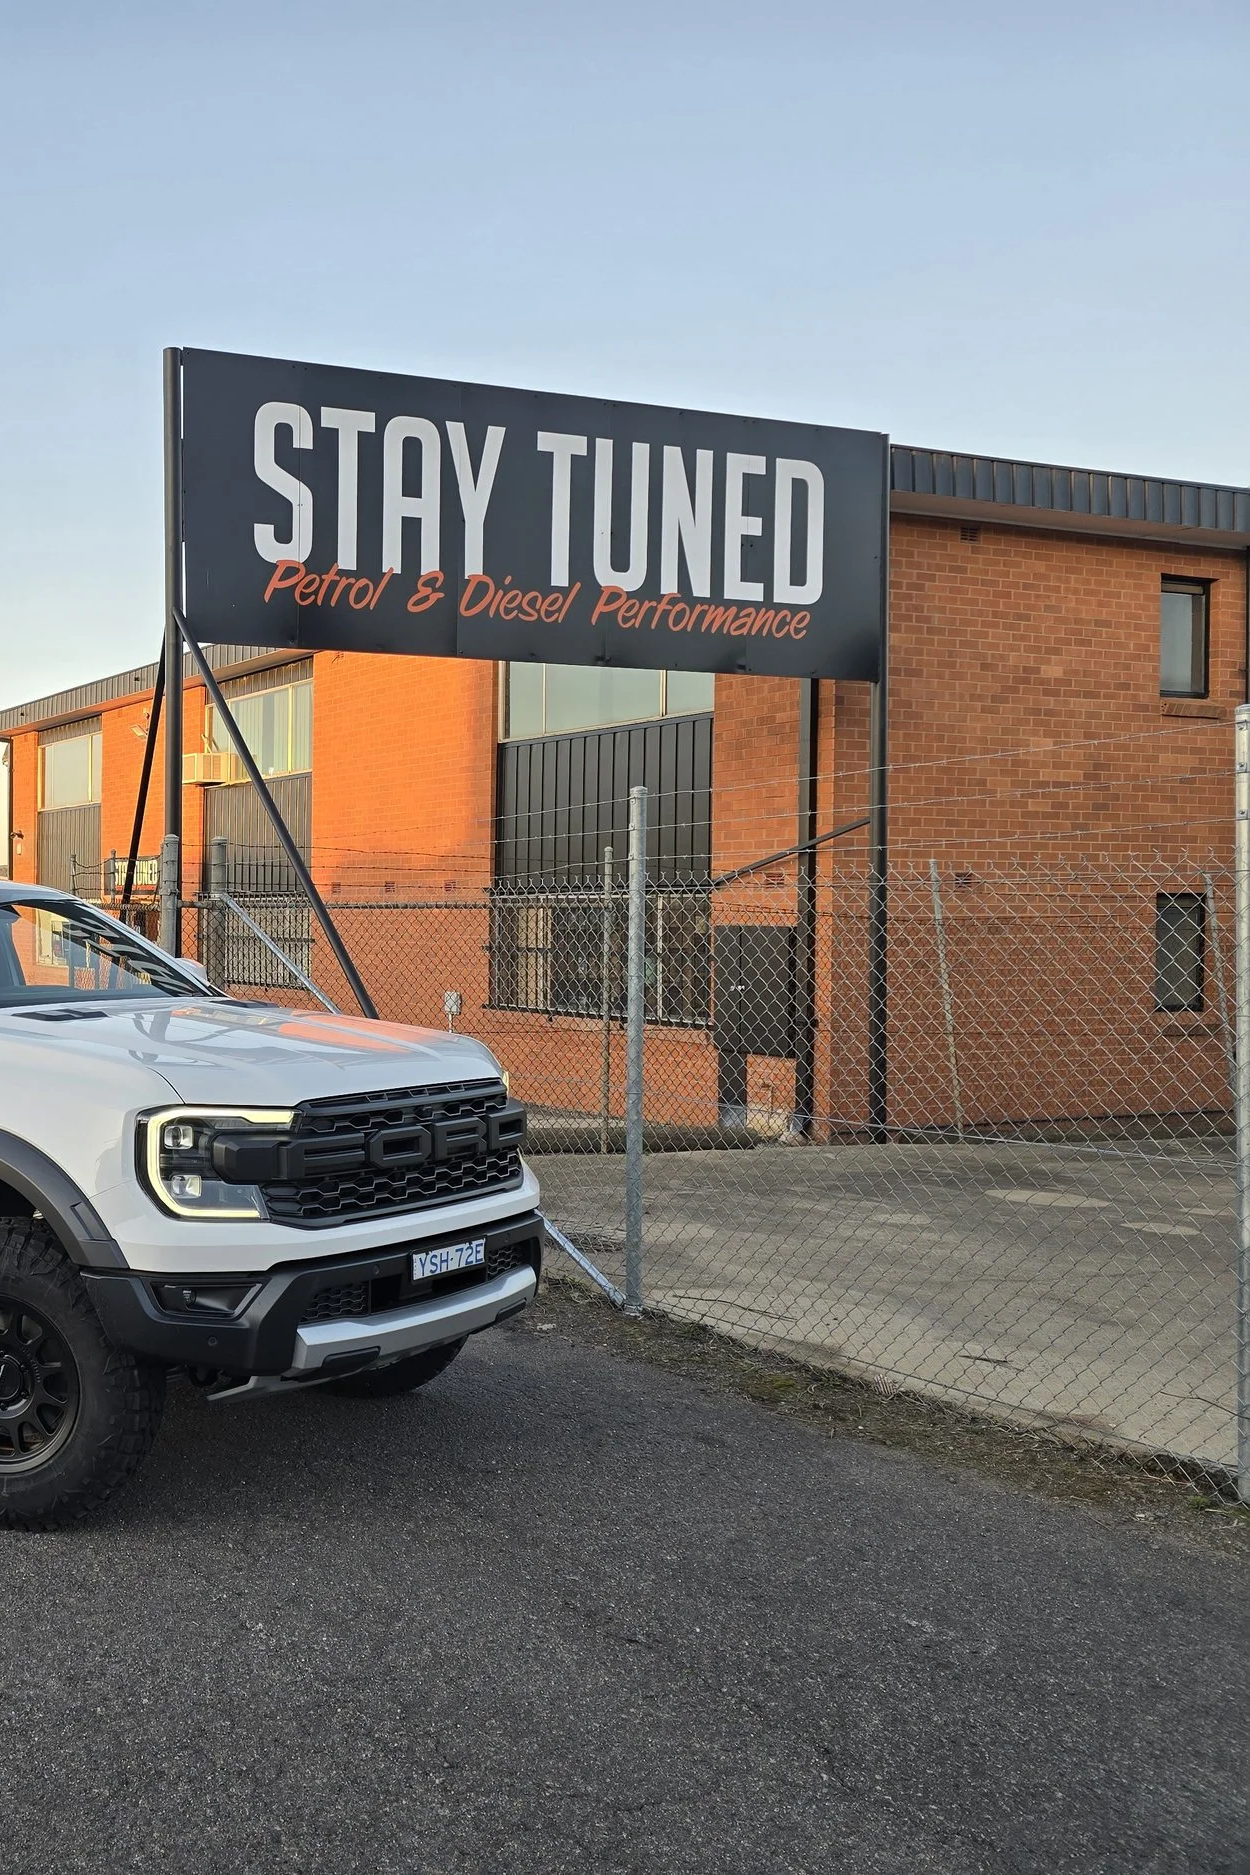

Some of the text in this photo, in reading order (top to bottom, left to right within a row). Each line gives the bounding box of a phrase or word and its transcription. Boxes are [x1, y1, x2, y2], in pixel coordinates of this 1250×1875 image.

[254, 401, 824, 605] STAY TUNED
[263, 559, 810, 640] Petrol & Diesel Performance
[287, 1106, 528, 1181] FORD
